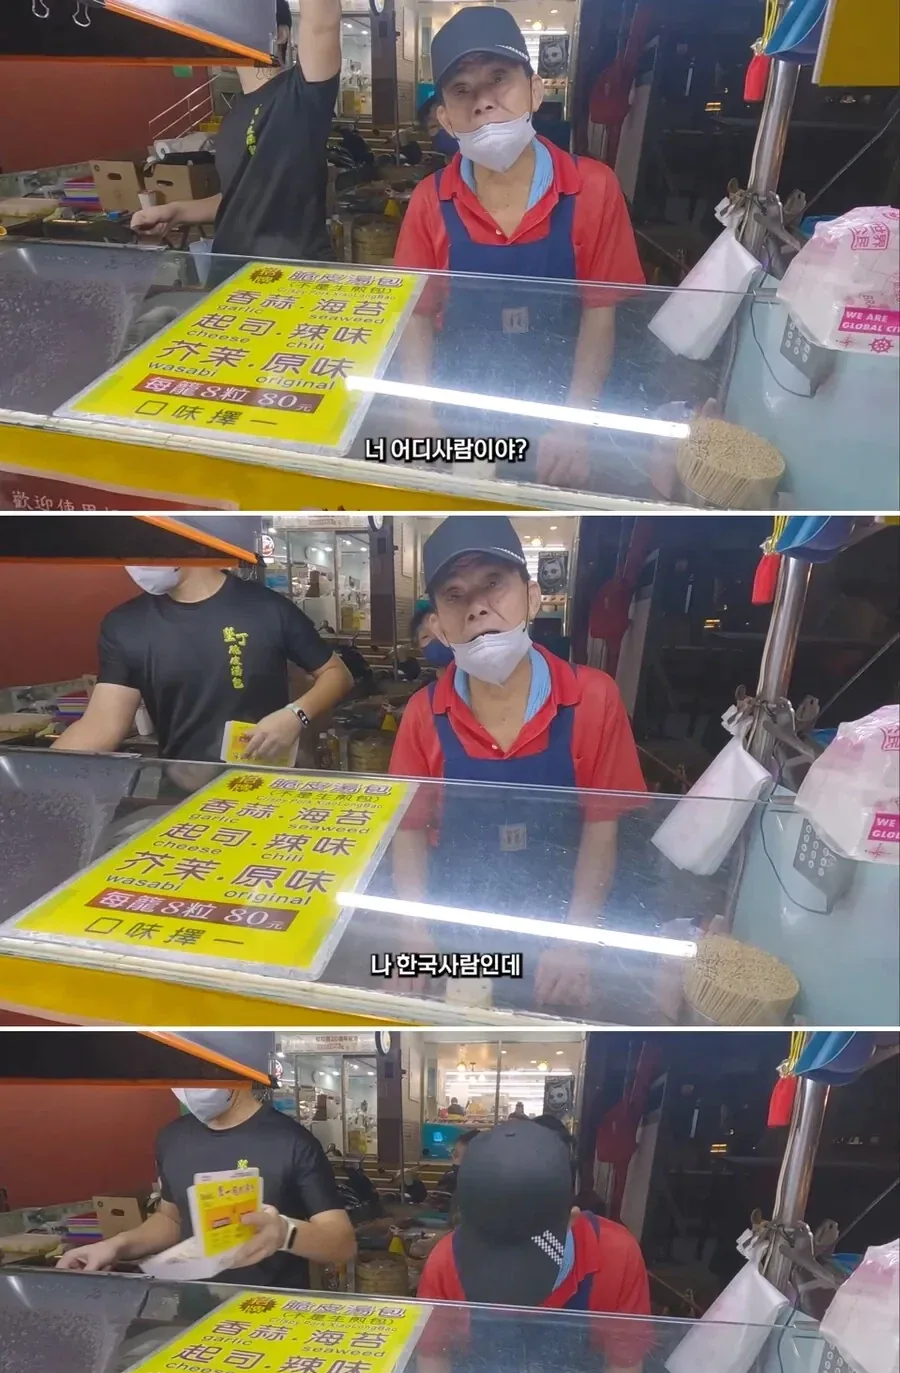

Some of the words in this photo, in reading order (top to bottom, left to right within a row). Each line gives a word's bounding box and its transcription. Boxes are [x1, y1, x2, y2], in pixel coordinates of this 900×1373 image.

[846, 311, 864, 320] WE
[866, 312, 889, 323] ARE
[842, 322, 882, 332] GLOBAL
[148, 361, 216, 377] wasabi
[255, 376, 335, 390] original
[188, 813, 239, 823] garlic
[287, 821, 370, 834] seaweed
[876, 817, 896, 828] WE
[152, 840, 222, 854] cheese
[260, 852, 303, 862] chili
[106, 874, 181, 891] wasabi
[223, 890, 312, 905] original
[301, 1344, 385, 1357] seaweed
